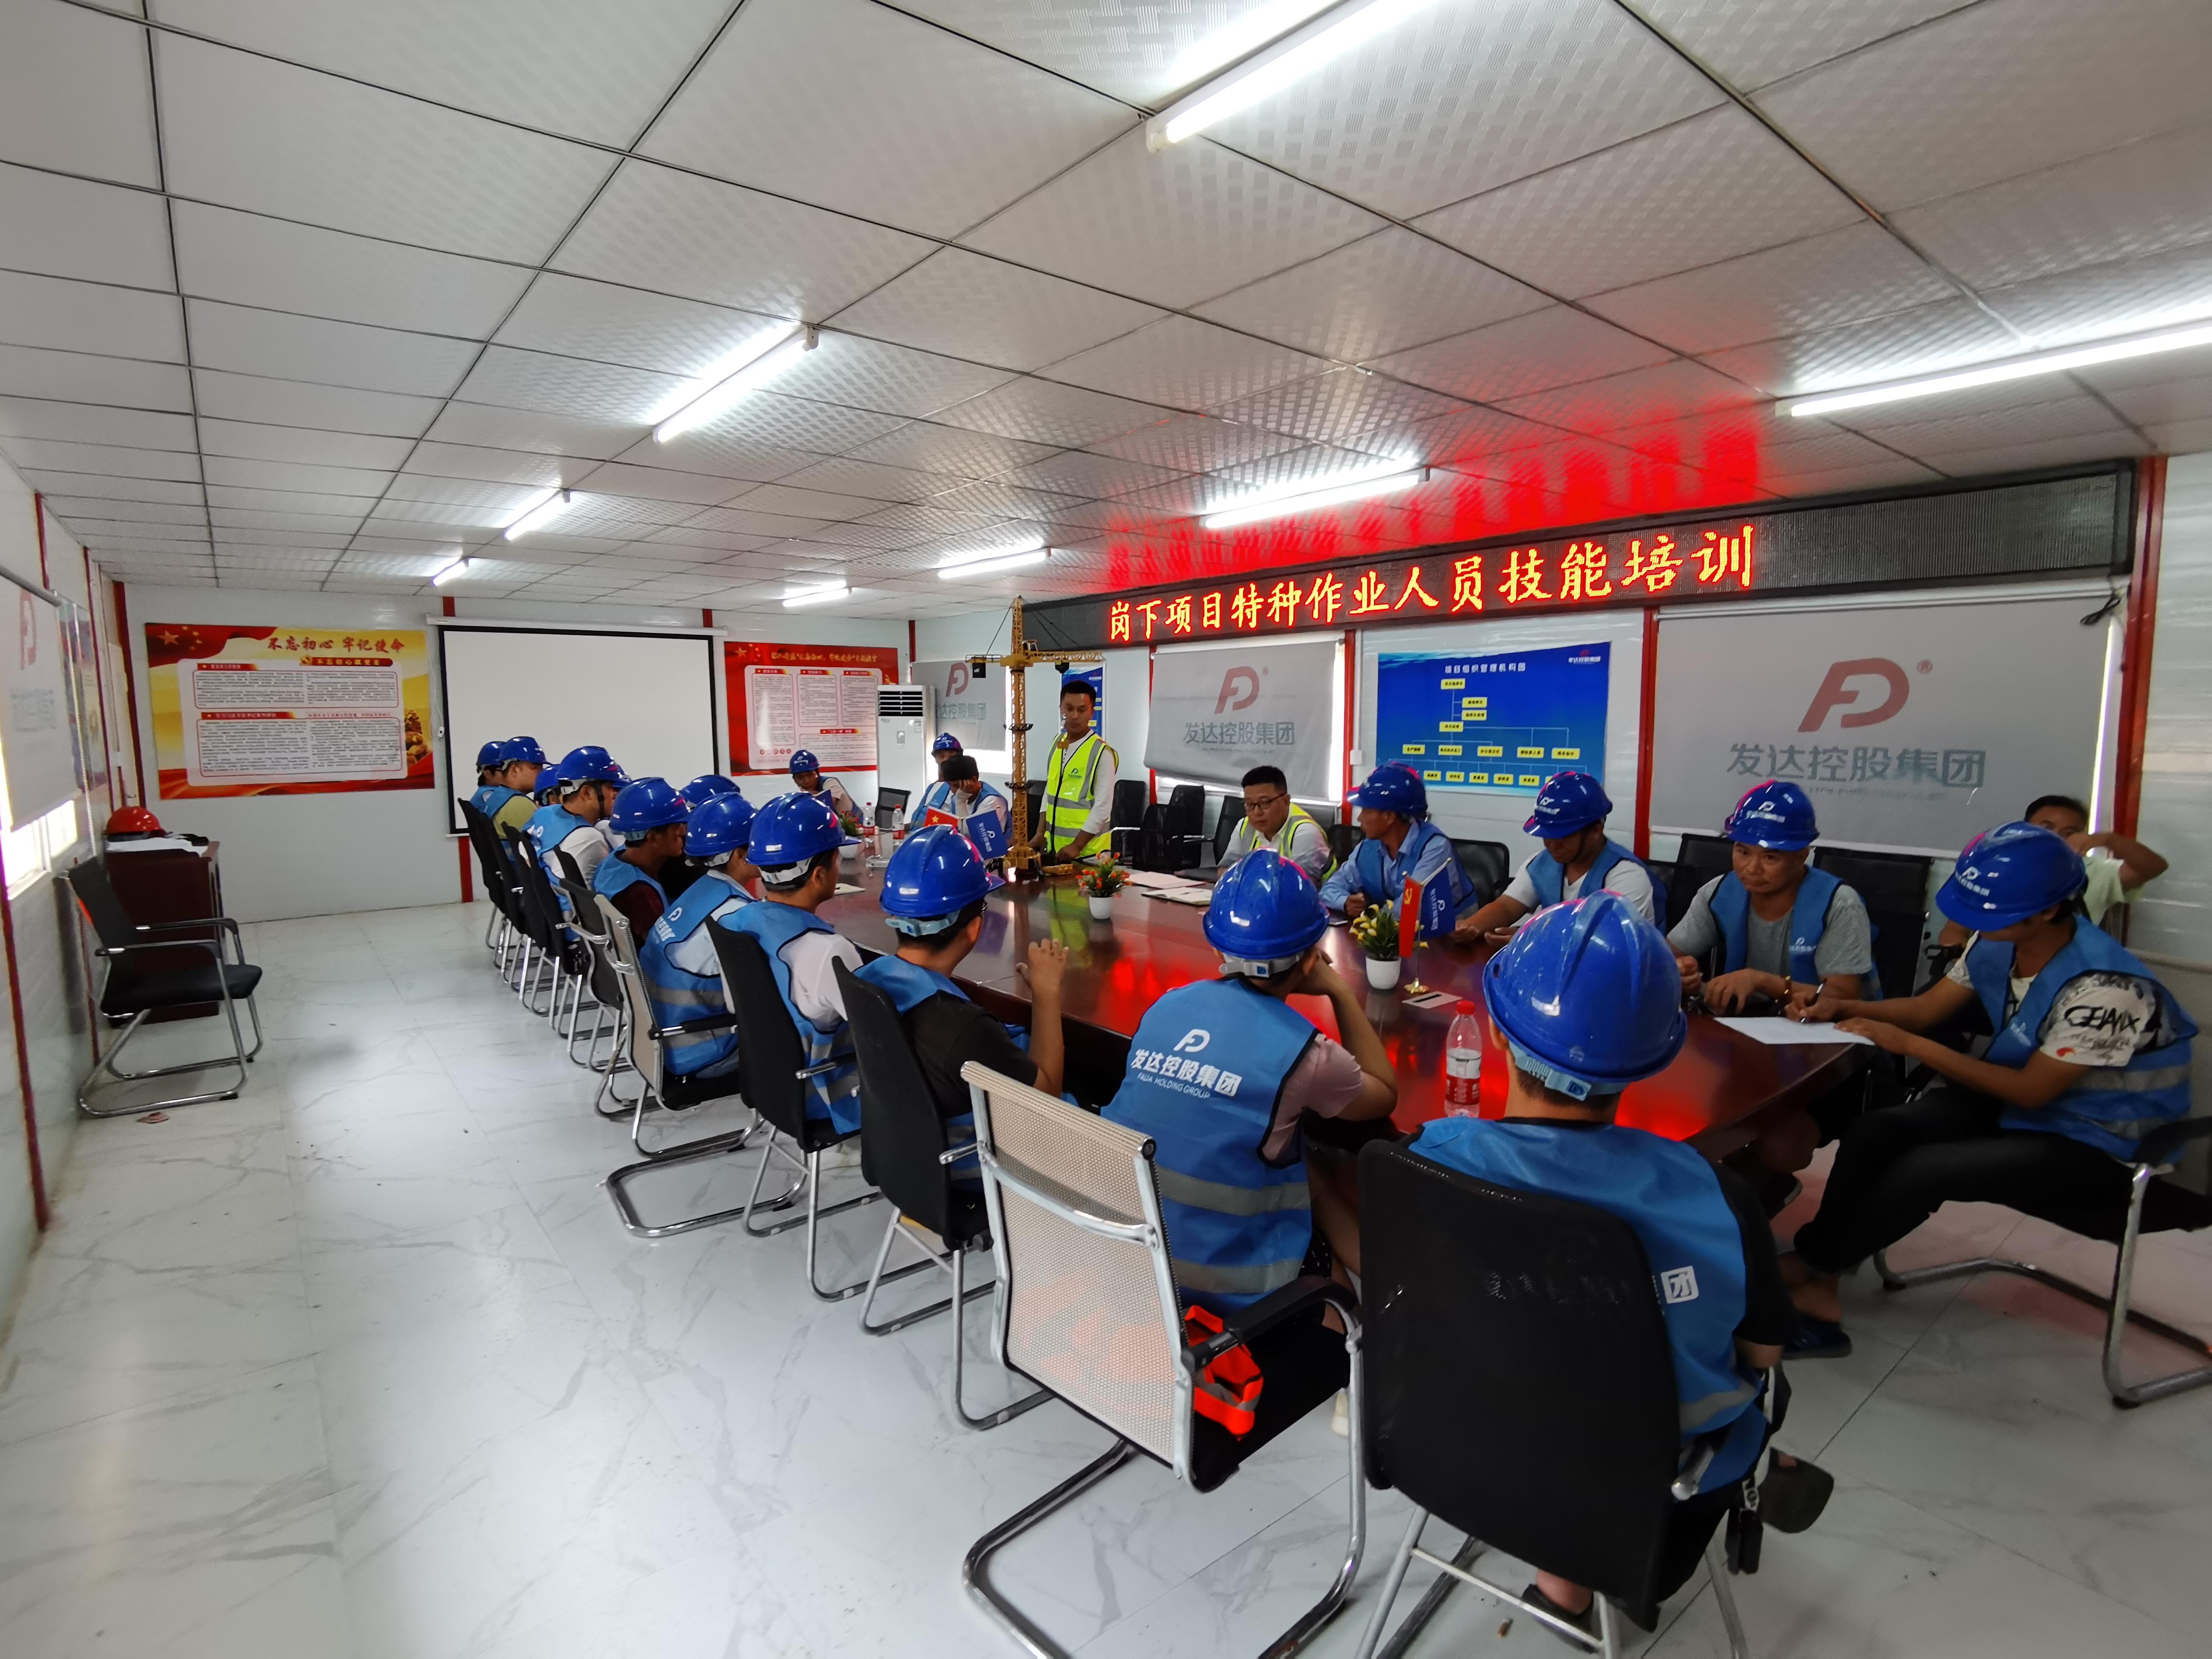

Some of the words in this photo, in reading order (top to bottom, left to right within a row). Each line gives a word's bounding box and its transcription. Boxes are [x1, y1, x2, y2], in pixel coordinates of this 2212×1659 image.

[1110, 525, 1755, 642] 岗下项目特种作业人员技能培训
[267, 635, 334, 651] 不忘初心
[342, 636, 405, 653] 牢记使命
[1183, 721, 1295, 745] 发达控股集团
[1727, 743, 1986, 788] 发达控股集团
[1130, 1049, 1242, 1097] 发达控股集团
